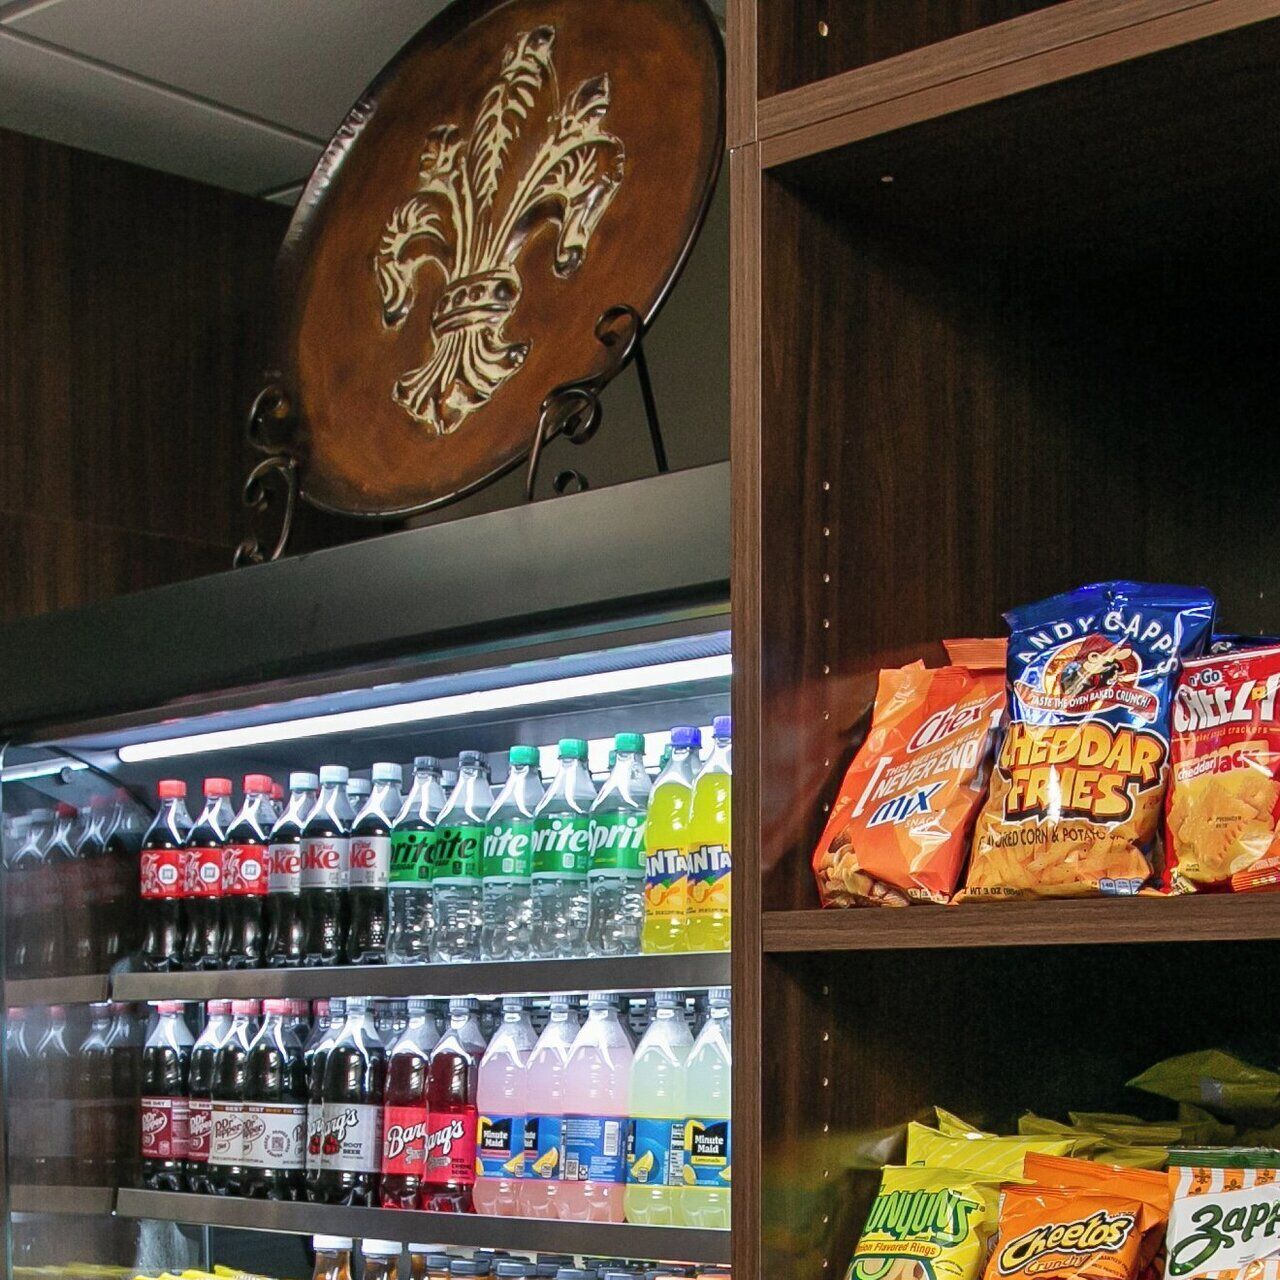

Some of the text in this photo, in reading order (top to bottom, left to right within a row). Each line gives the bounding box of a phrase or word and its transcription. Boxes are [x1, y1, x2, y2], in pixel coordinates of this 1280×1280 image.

[1017, 618, 1094, 663] ANDY
[1069, 693, 1089, 707] OVEN
[1089, 687, 1115, 703] BAKED
[1115, 687, 1152, 709] CRUNCH!
[1001, 723, 1162, 783] CHEDDAR
[1007, 767, 1129, 816] FRIES
[1021, 827, 1048, 846] CORN
[483, 1130, 509, 1140] Minute
[485, 1138, 504, 1148] Maid
[694, 1134, 725, 1146] Minute
[697, 1143, 720, 1154] Maid
[874, 1240, 937, 1256] Flavored Rings
[1001, 1213, 1136, 1276] Cheetos
[1024, 1252, 1091, 1275] Crunchy
